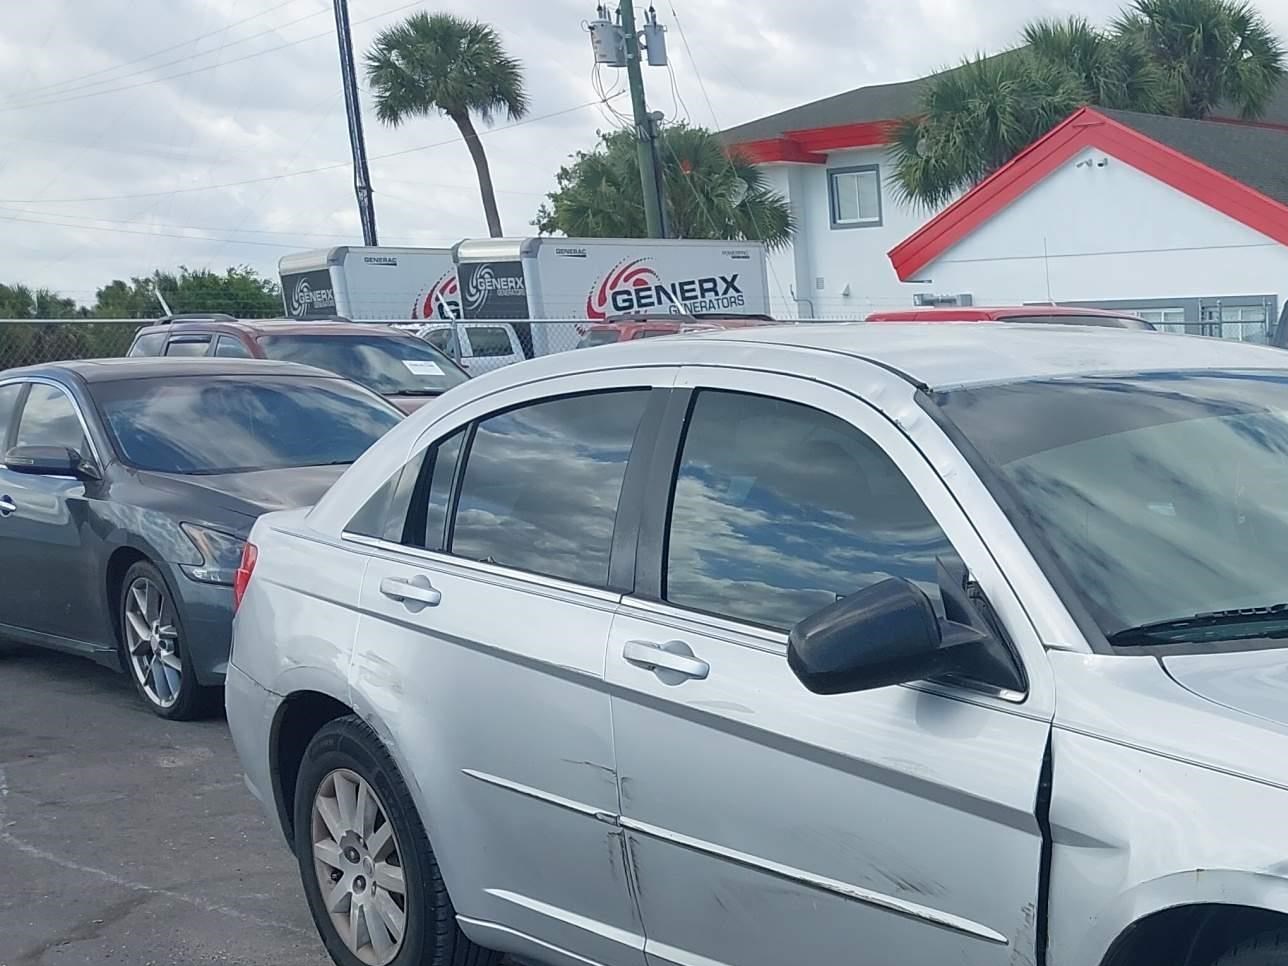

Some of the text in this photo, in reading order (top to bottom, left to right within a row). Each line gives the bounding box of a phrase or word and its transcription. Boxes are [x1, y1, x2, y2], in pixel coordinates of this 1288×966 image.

[477, 277, 525, 290] GENERX
[299, 289, 334, 303] GENERX
[611, 274, 743, 312] GENERX
[669, 294, 745, 315] GNERATORS
